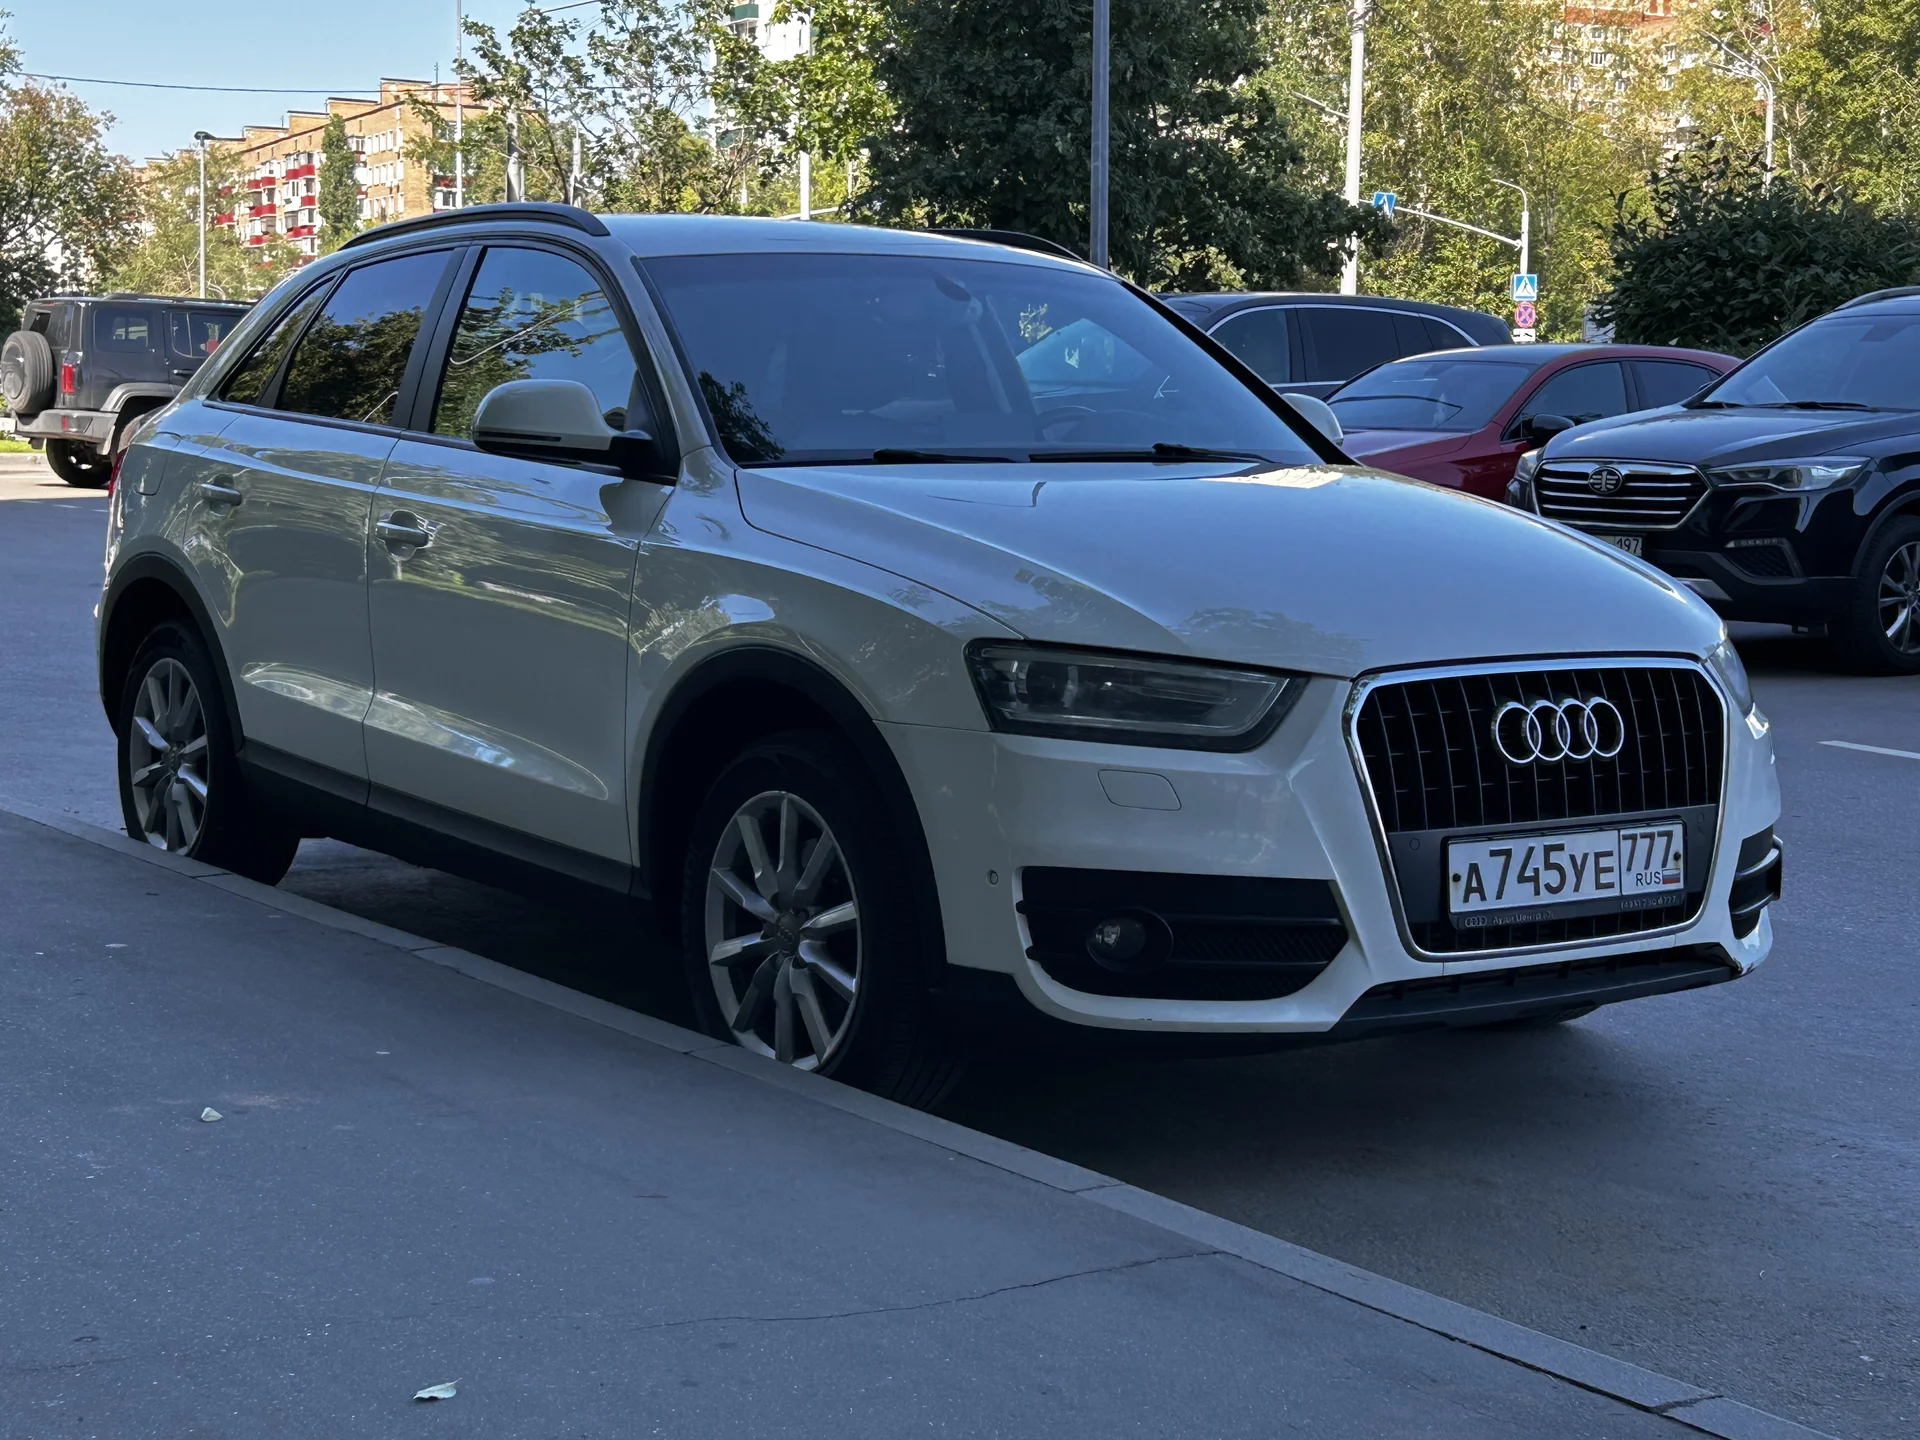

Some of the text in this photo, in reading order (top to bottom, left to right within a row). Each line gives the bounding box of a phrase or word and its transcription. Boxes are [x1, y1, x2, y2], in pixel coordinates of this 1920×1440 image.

[1463, 830, 1674, 903] А745УЕ 777
[1635, 871, 1661, 886] RUS
